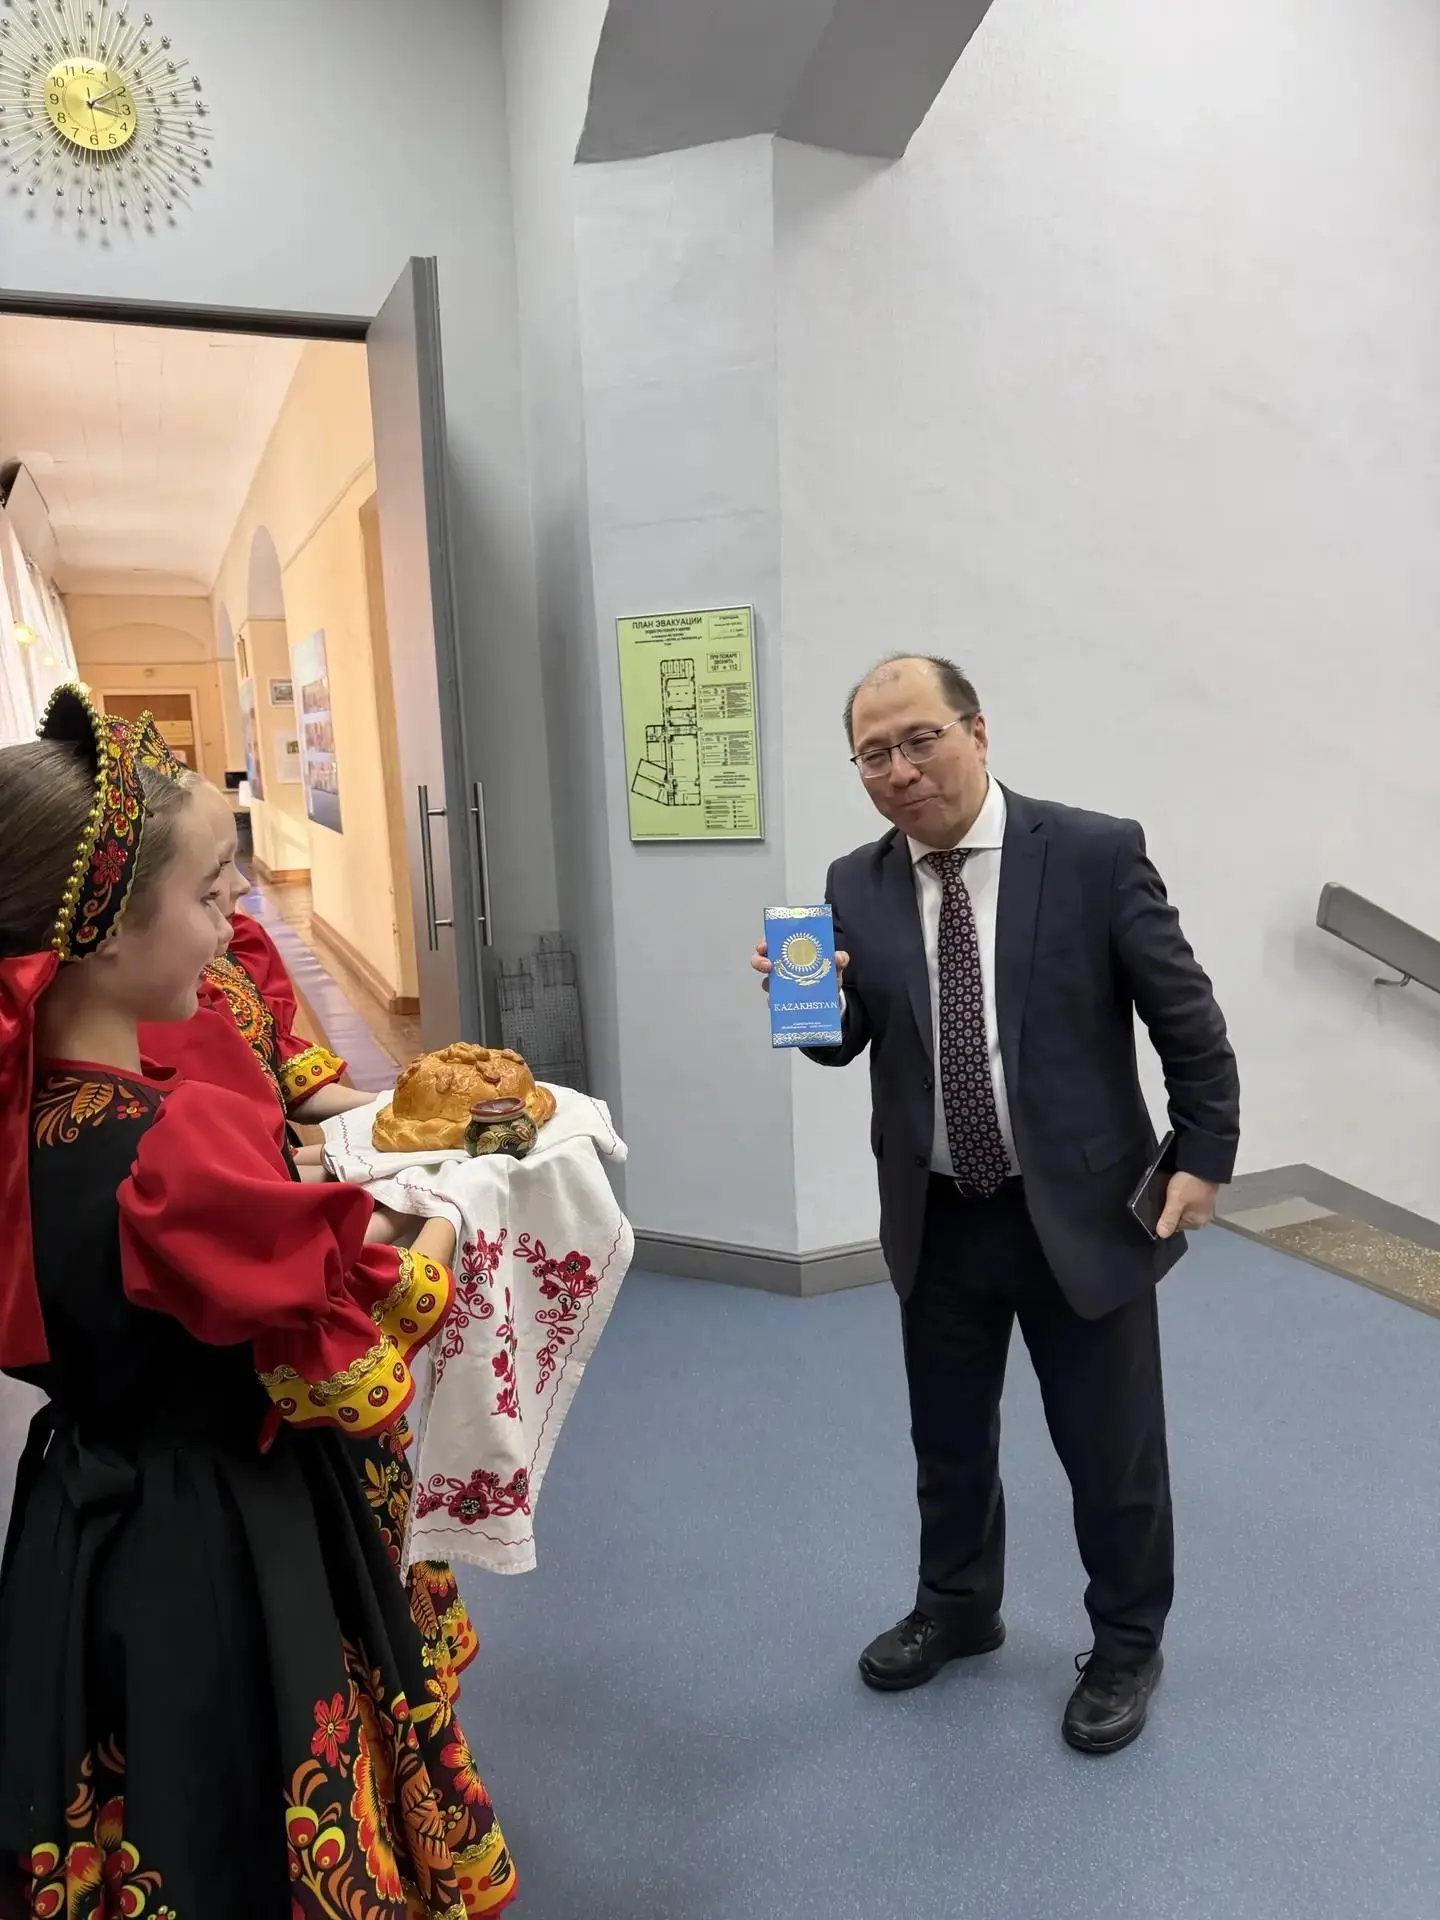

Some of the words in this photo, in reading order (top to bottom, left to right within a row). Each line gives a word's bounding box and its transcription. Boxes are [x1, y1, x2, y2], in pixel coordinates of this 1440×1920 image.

[64, 65, 75, 77] 11
[81, 65, 95, 76] 12
[51, 76, 65, 88] 10
[103, 71, 109, 82] 1
[117, 86, 127, 97] 2
[49, 94, 59, 105] 9
[122, 105, 131, 116] 3
[57, 112, 67, 124] 8
[71, 127, 80, 138] 7
[120, 122, 128, 133] 4
[89, 134, 99, 146] 6
[108, 133, 117, 144] 5
[632, 620, 654, 629] ПЛАН
[655, 617, 703, 628] ЭВАКУАЦИИ
[774, 1000, 838, 1012] KAZAKHSTAN
